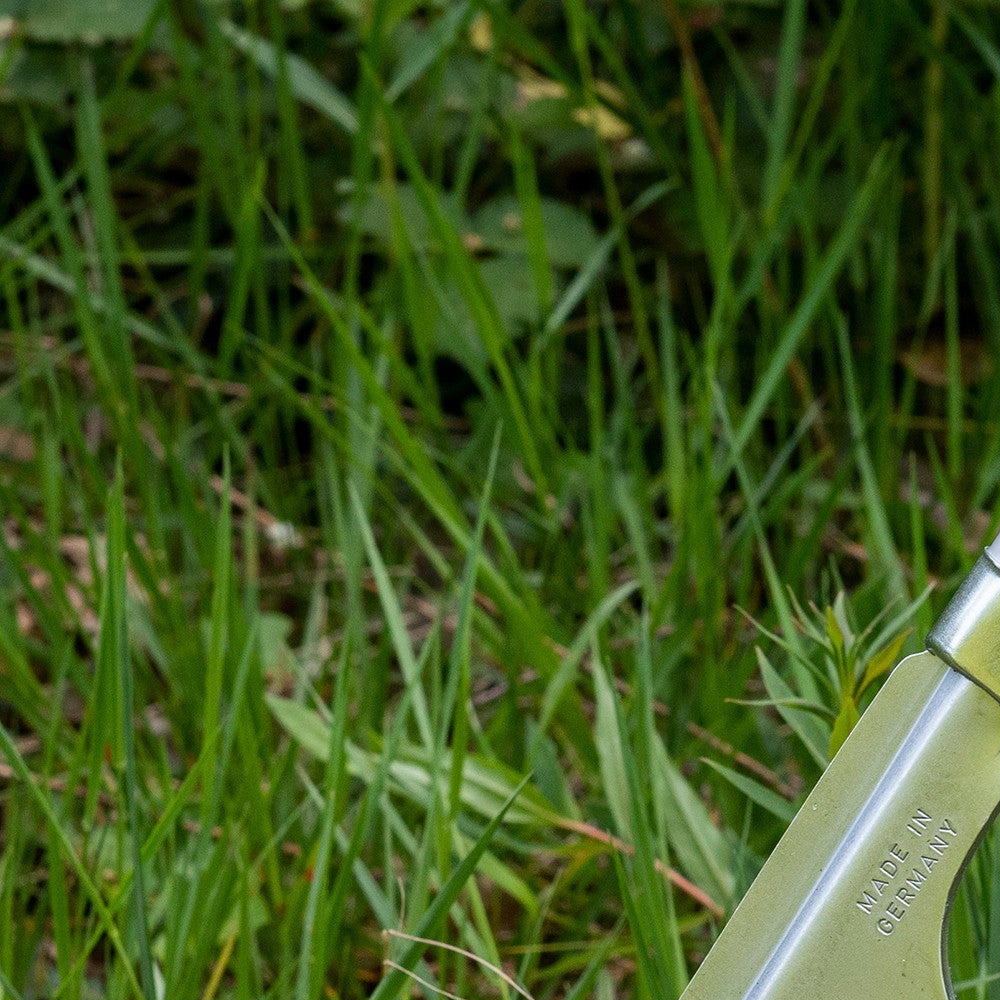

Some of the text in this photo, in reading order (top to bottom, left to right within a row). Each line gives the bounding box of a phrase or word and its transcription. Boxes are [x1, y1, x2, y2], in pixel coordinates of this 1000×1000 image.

[856, 808, 932, 915] MADE IN
[877, 819, 958, 936] GERMANY
